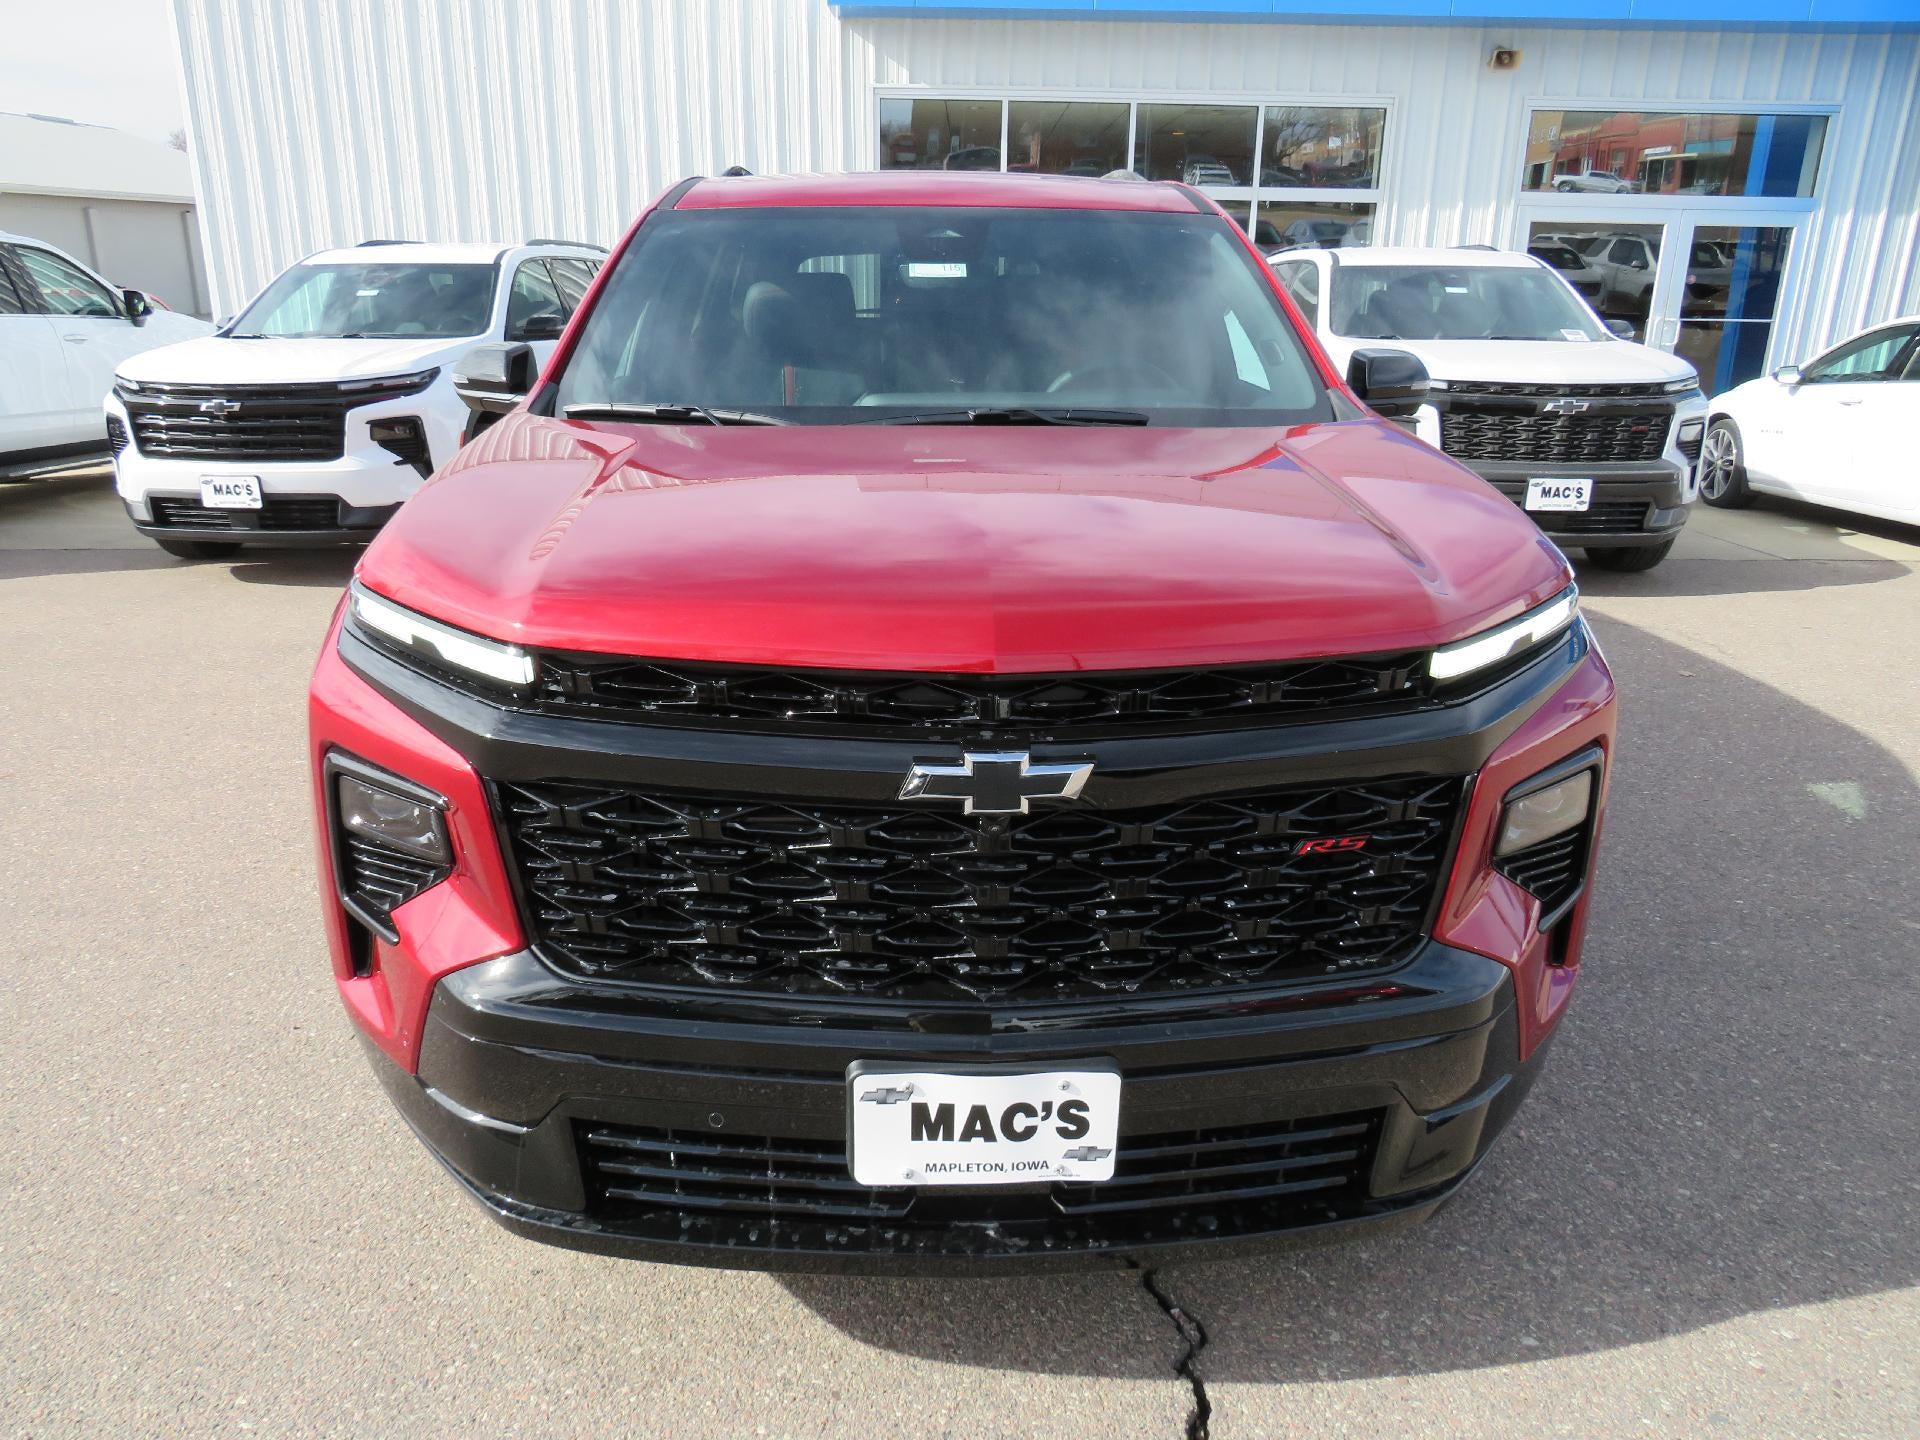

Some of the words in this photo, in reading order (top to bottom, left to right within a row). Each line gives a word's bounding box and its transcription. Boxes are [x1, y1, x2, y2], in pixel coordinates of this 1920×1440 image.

[213, 484, 253, 496] MAC'S
[1541, 486, 1584, 499] MAC'S
[1296, 835, 1371, 855] RS
[911, 1099, 1090, 1143] MAC'S
[925, 1162, 1008, 1174] MAPLETON,
[1011, 1160, 1050, 1172] IOWA
